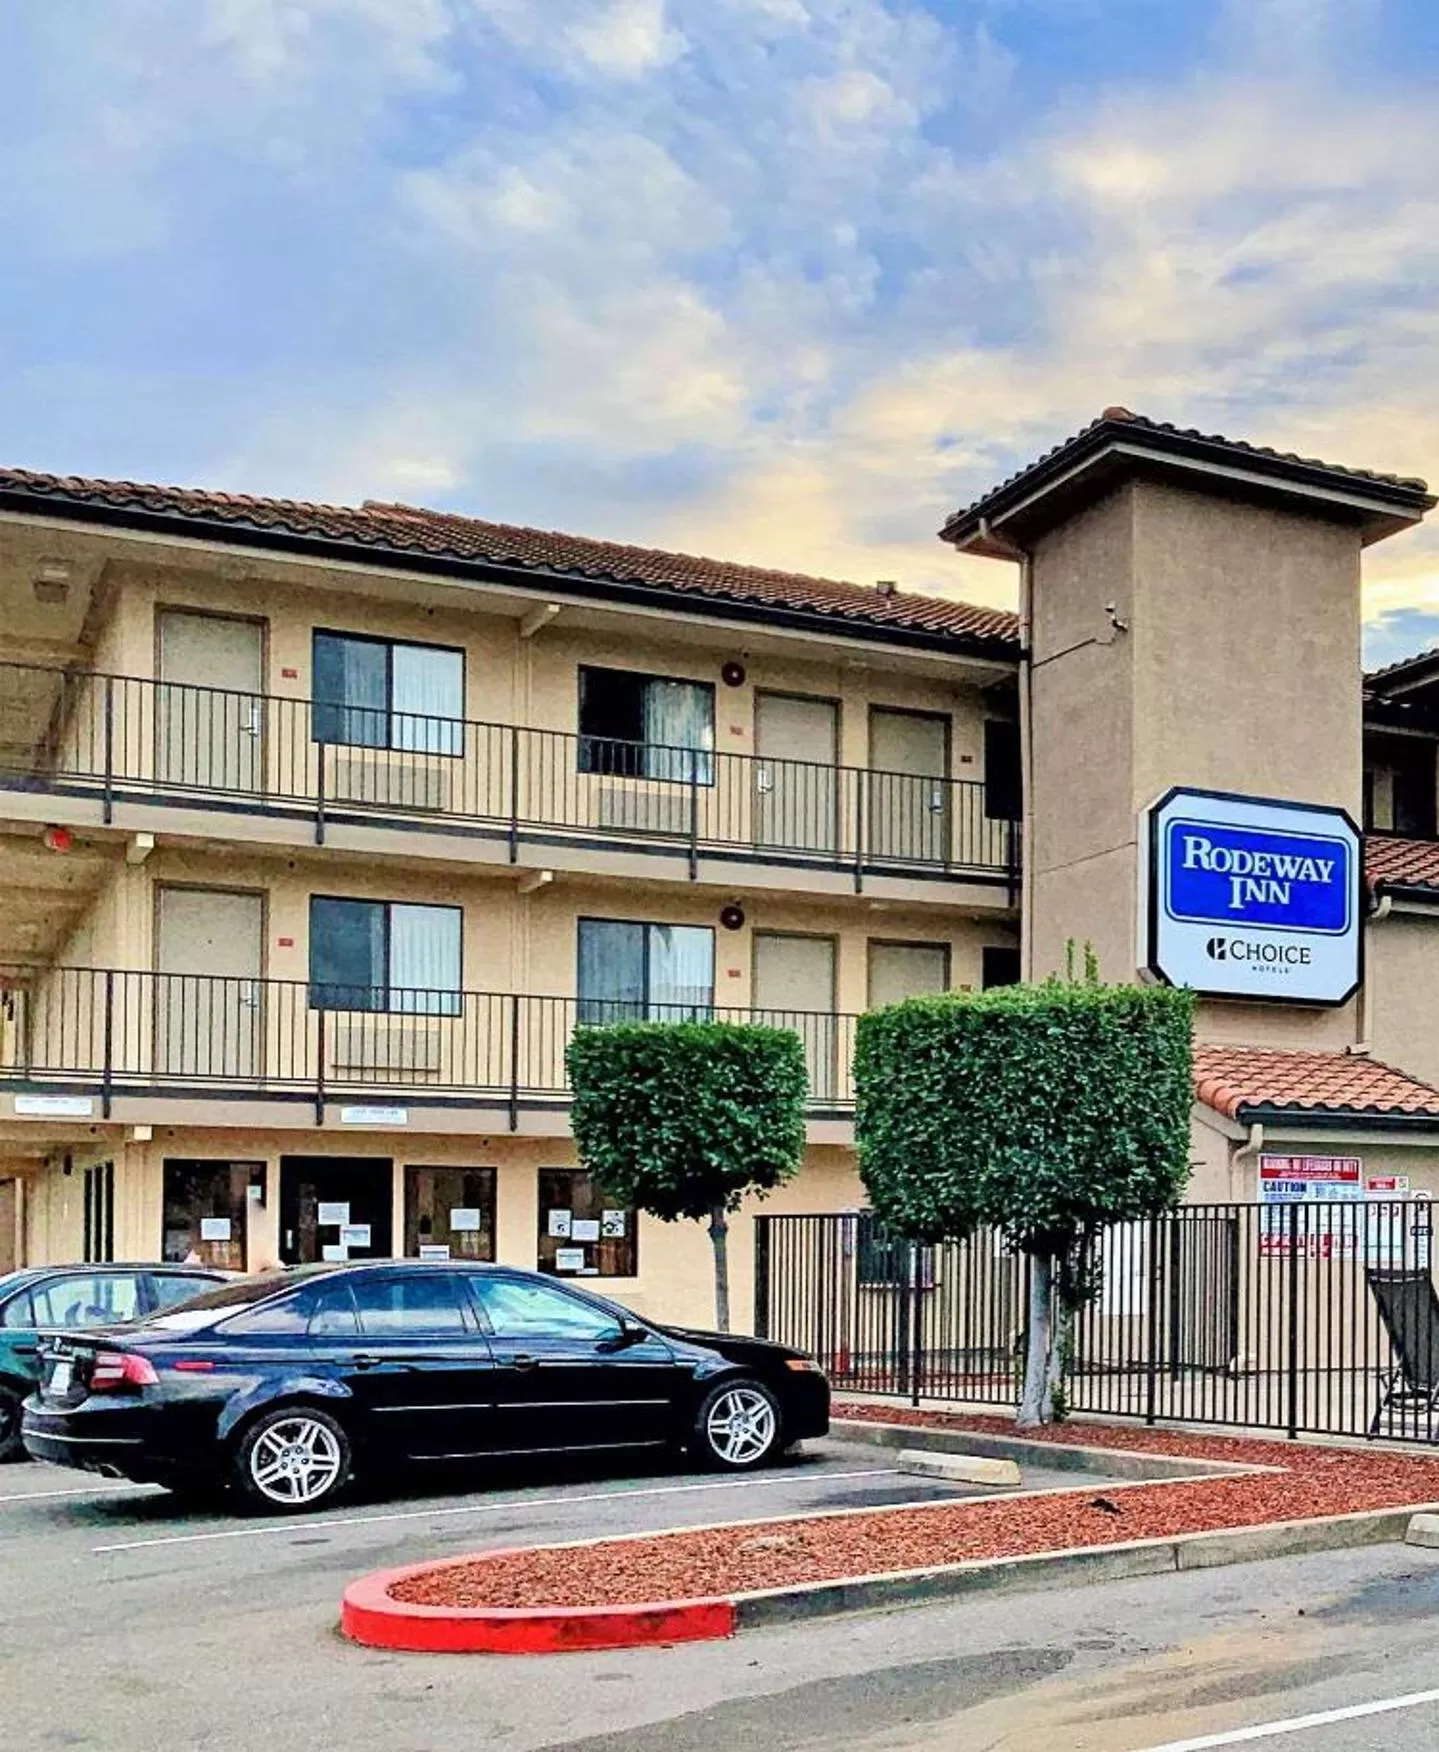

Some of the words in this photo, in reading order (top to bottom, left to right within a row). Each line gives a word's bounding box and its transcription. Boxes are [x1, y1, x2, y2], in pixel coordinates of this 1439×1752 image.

[1182, 836, 1335, 883] RODEWAY
[1228, 876, 1290, 908] INN
[1230, 940, 1311, 964] CHOICE
[1263, 1181, 1307, 1192] CAUTION
